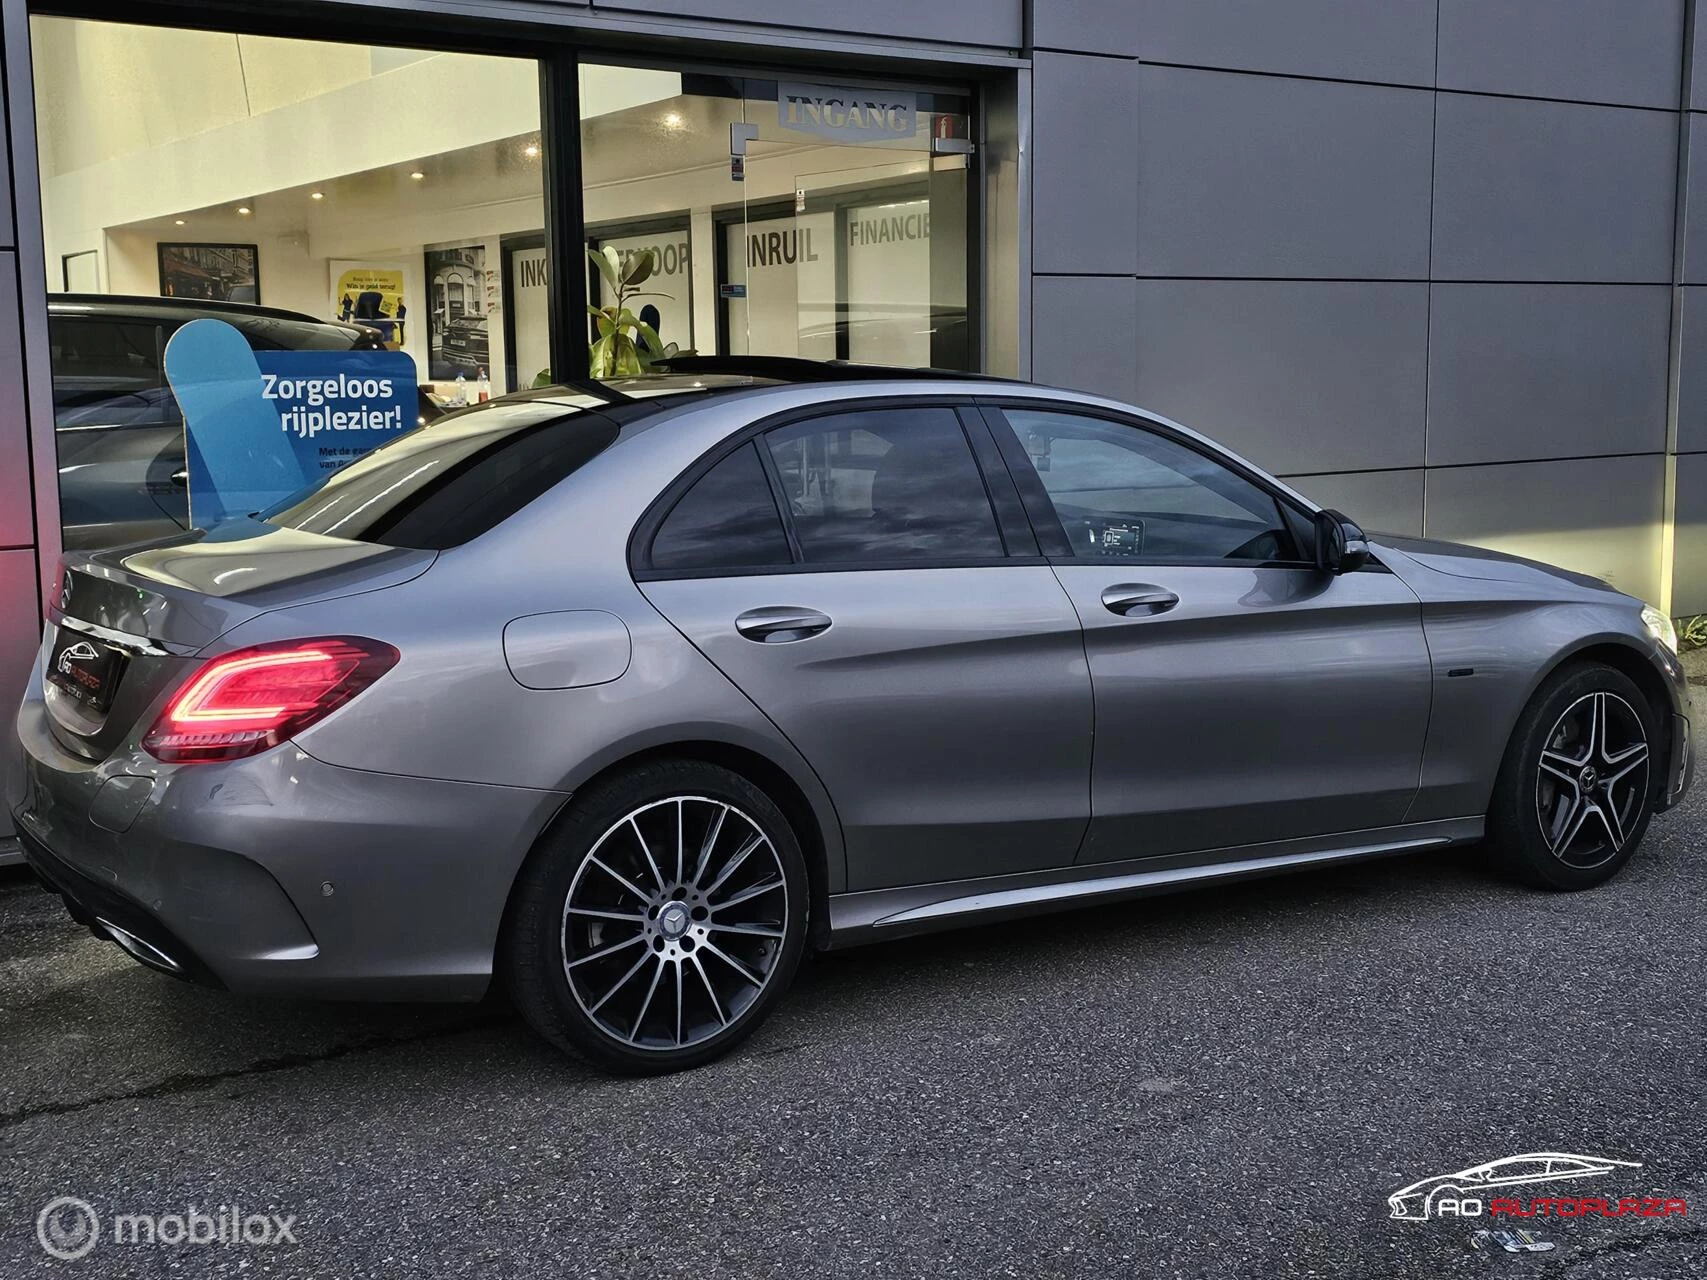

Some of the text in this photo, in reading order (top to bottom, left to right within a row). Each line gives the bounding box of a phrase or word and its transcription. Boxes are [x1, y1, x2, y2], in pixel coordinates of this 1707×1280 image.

[786, 95, 908, 132] INGANG
[747, 228, 818, 268] INRUIL
[261, 373, 393, 405] Zorgeloos
[281, 405, 402, 438] rijplezier!
[318, 447, 338, 456] Met
[340, 446, 351, 455] de
[319, 461, 336, 469] van
